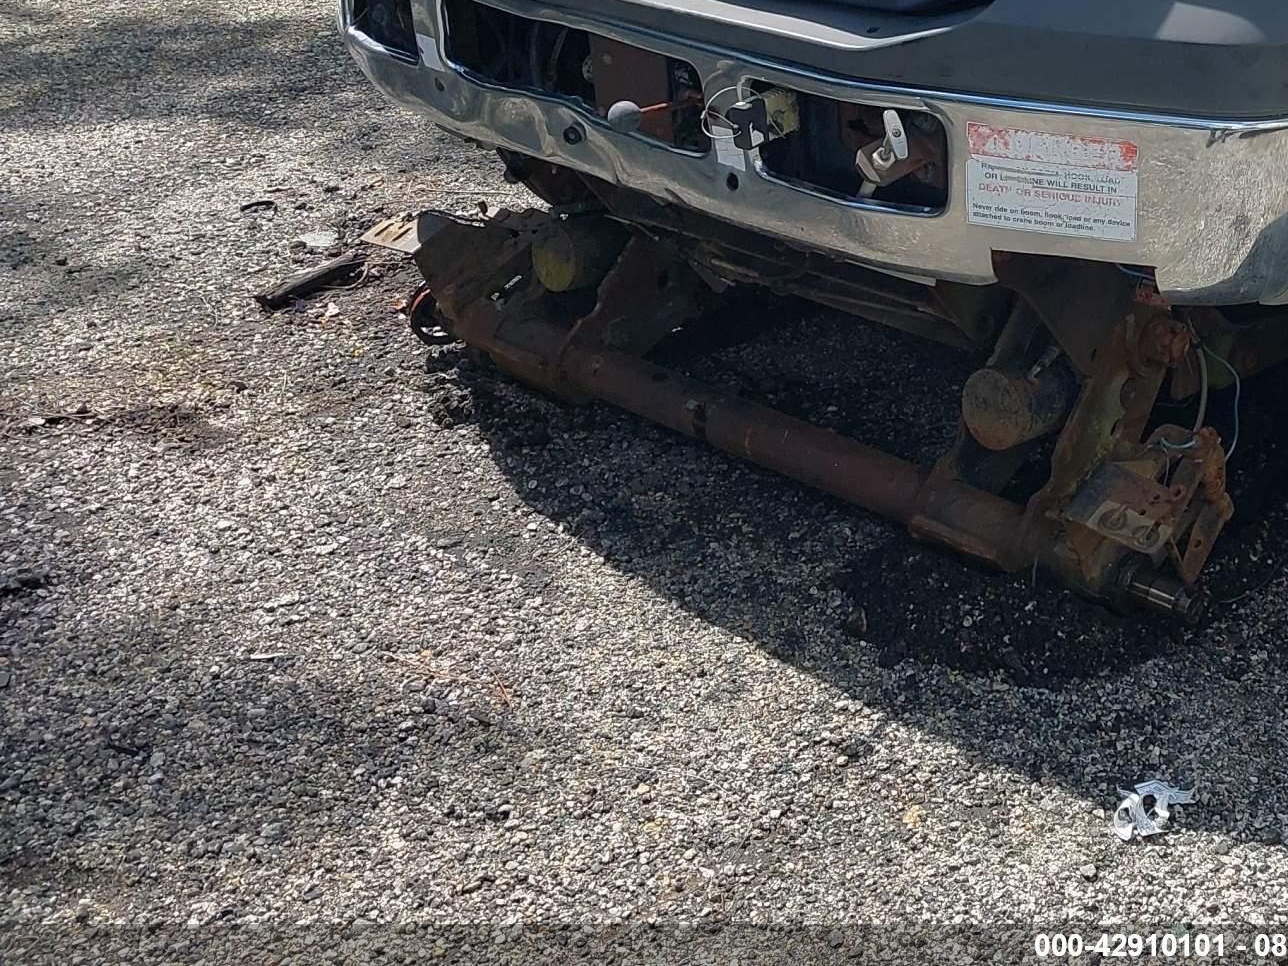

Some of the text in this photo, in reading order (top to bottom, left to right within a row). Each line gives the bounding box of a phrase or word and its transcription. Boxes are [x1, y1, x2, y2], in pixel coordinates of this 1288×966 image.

[984, 171, 998, 180] OR
[1046, 179, 1068, 189] WILL
[1070, 182, 1105, 193] RESULT
[1107, 185, 1118, 194] IN
[972, 202, 993, 211] Never
[1092, 218, 1106, 226] any
[1107, 218, 1131, 227] device
[972, 211, 1002, 221] attached
[1013, 216, 1032, 224] crane
[1034, 218, 1055, 227] boom
